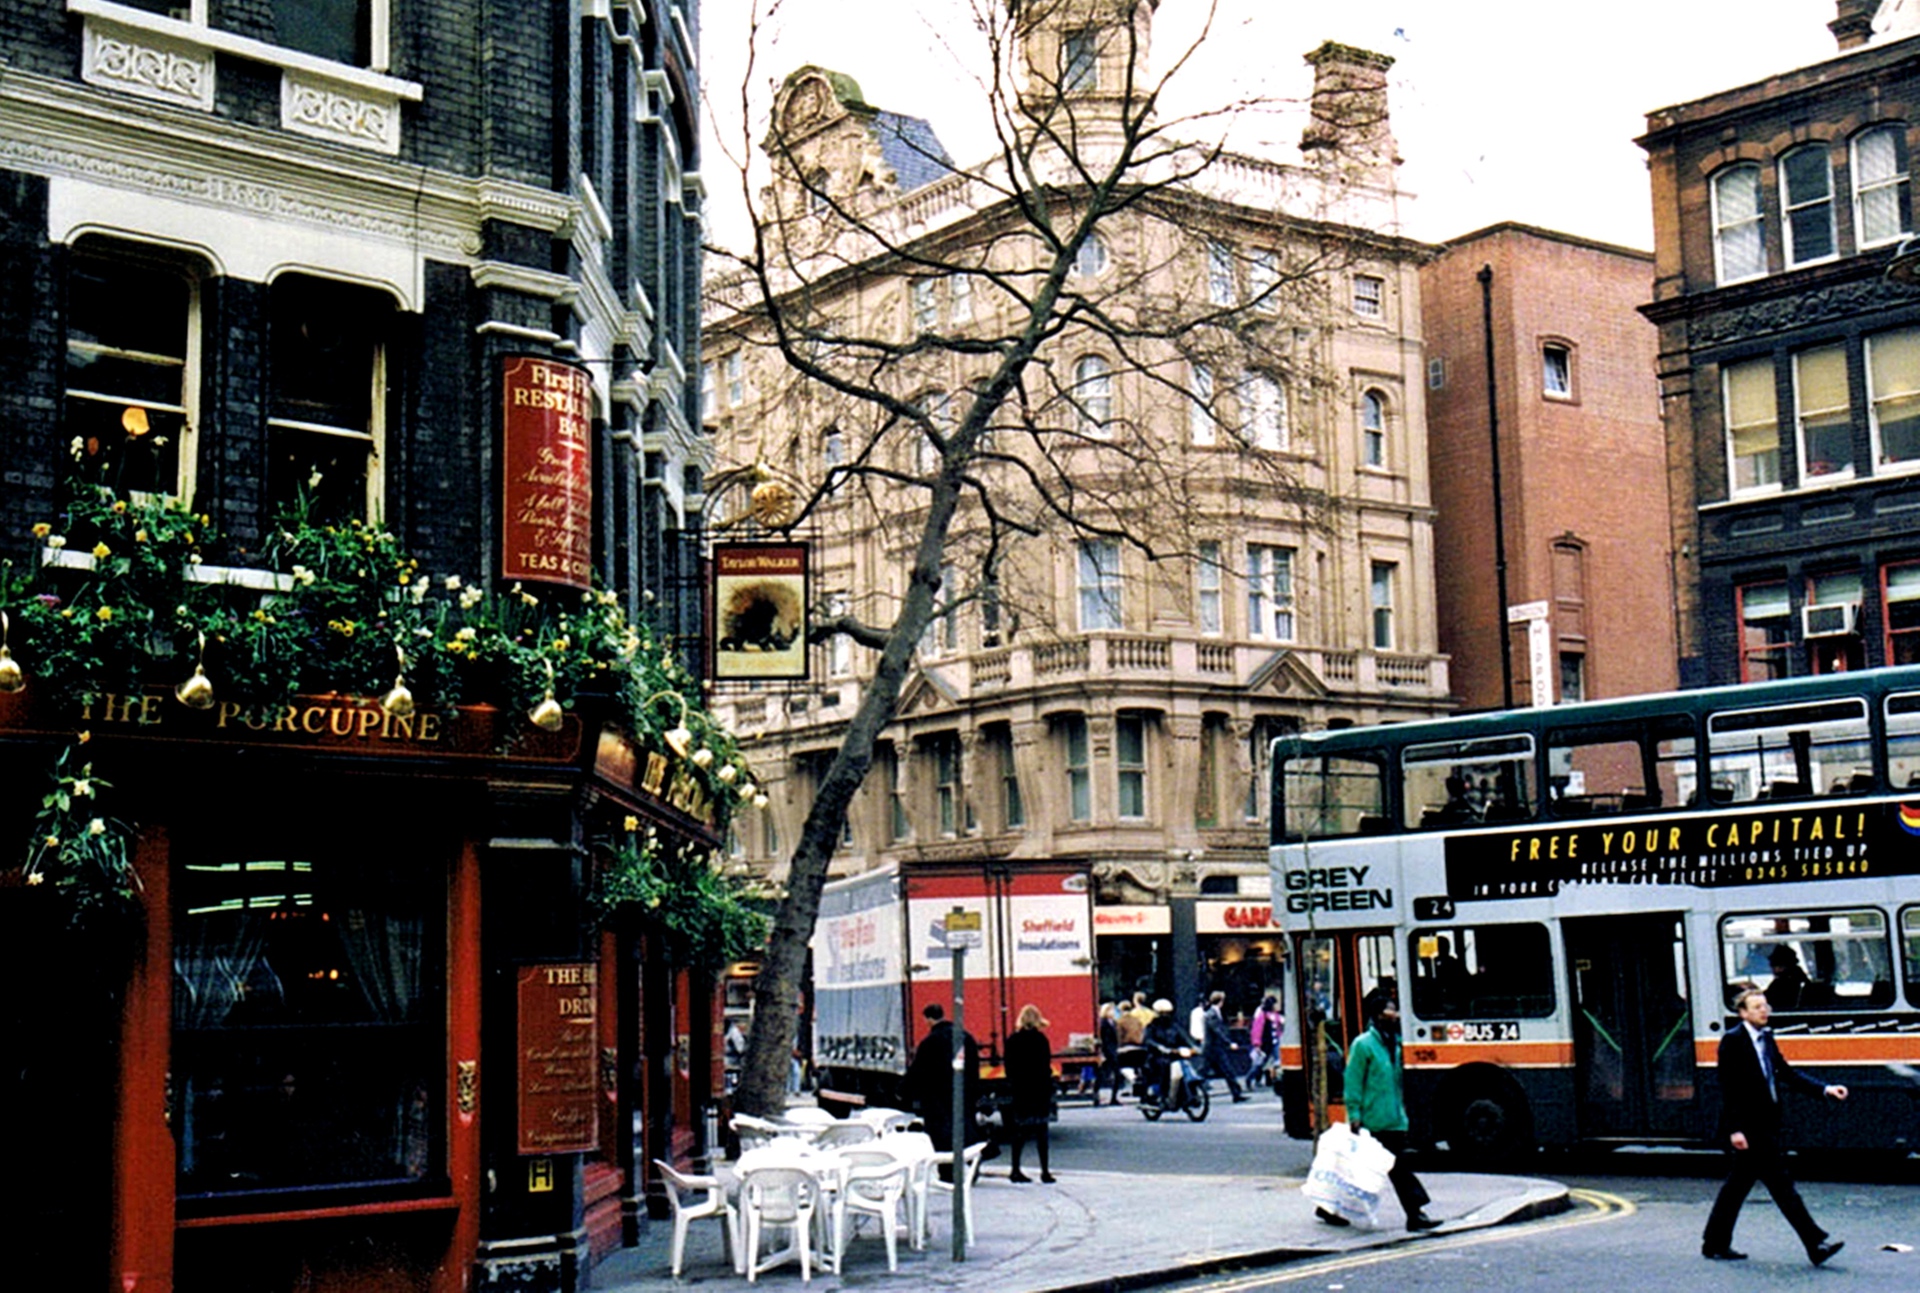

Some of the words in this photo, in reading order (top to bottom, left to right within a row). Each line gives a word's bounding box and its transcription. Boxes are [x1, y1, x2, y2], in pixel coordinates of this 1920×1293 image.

[519, 552, 558, 570] TEAS
[80, 692, 163, 725] THE
[217, 700, 441, 741] PORCUPINE
[1511, 834, 1578, 862] FREE
[1602, 827, 1681, 855] YOUR
[1707, 813, 1865, 848] CAPITAL!
[1581, 858, 1647, 875] RELEASE
[1659, 855, 1687, 870] THE
[1699, 849, 1781, 867] MILLIONS
[1794, 846, 1833, 861] TIED
[1846, 843, 1867, 857] UP
[1285, 865, 1370, 891] GREY
[1286, 888, 1393, 914] GREEN
[1430, 899, 1452, 915] 24
[1223, 906, 1281, 929] GARF
[543, 967, 580, 985] THE
[1464, 1023, 1494, 1040] BUS
[1500, 1023, 1518, 1039] 24
